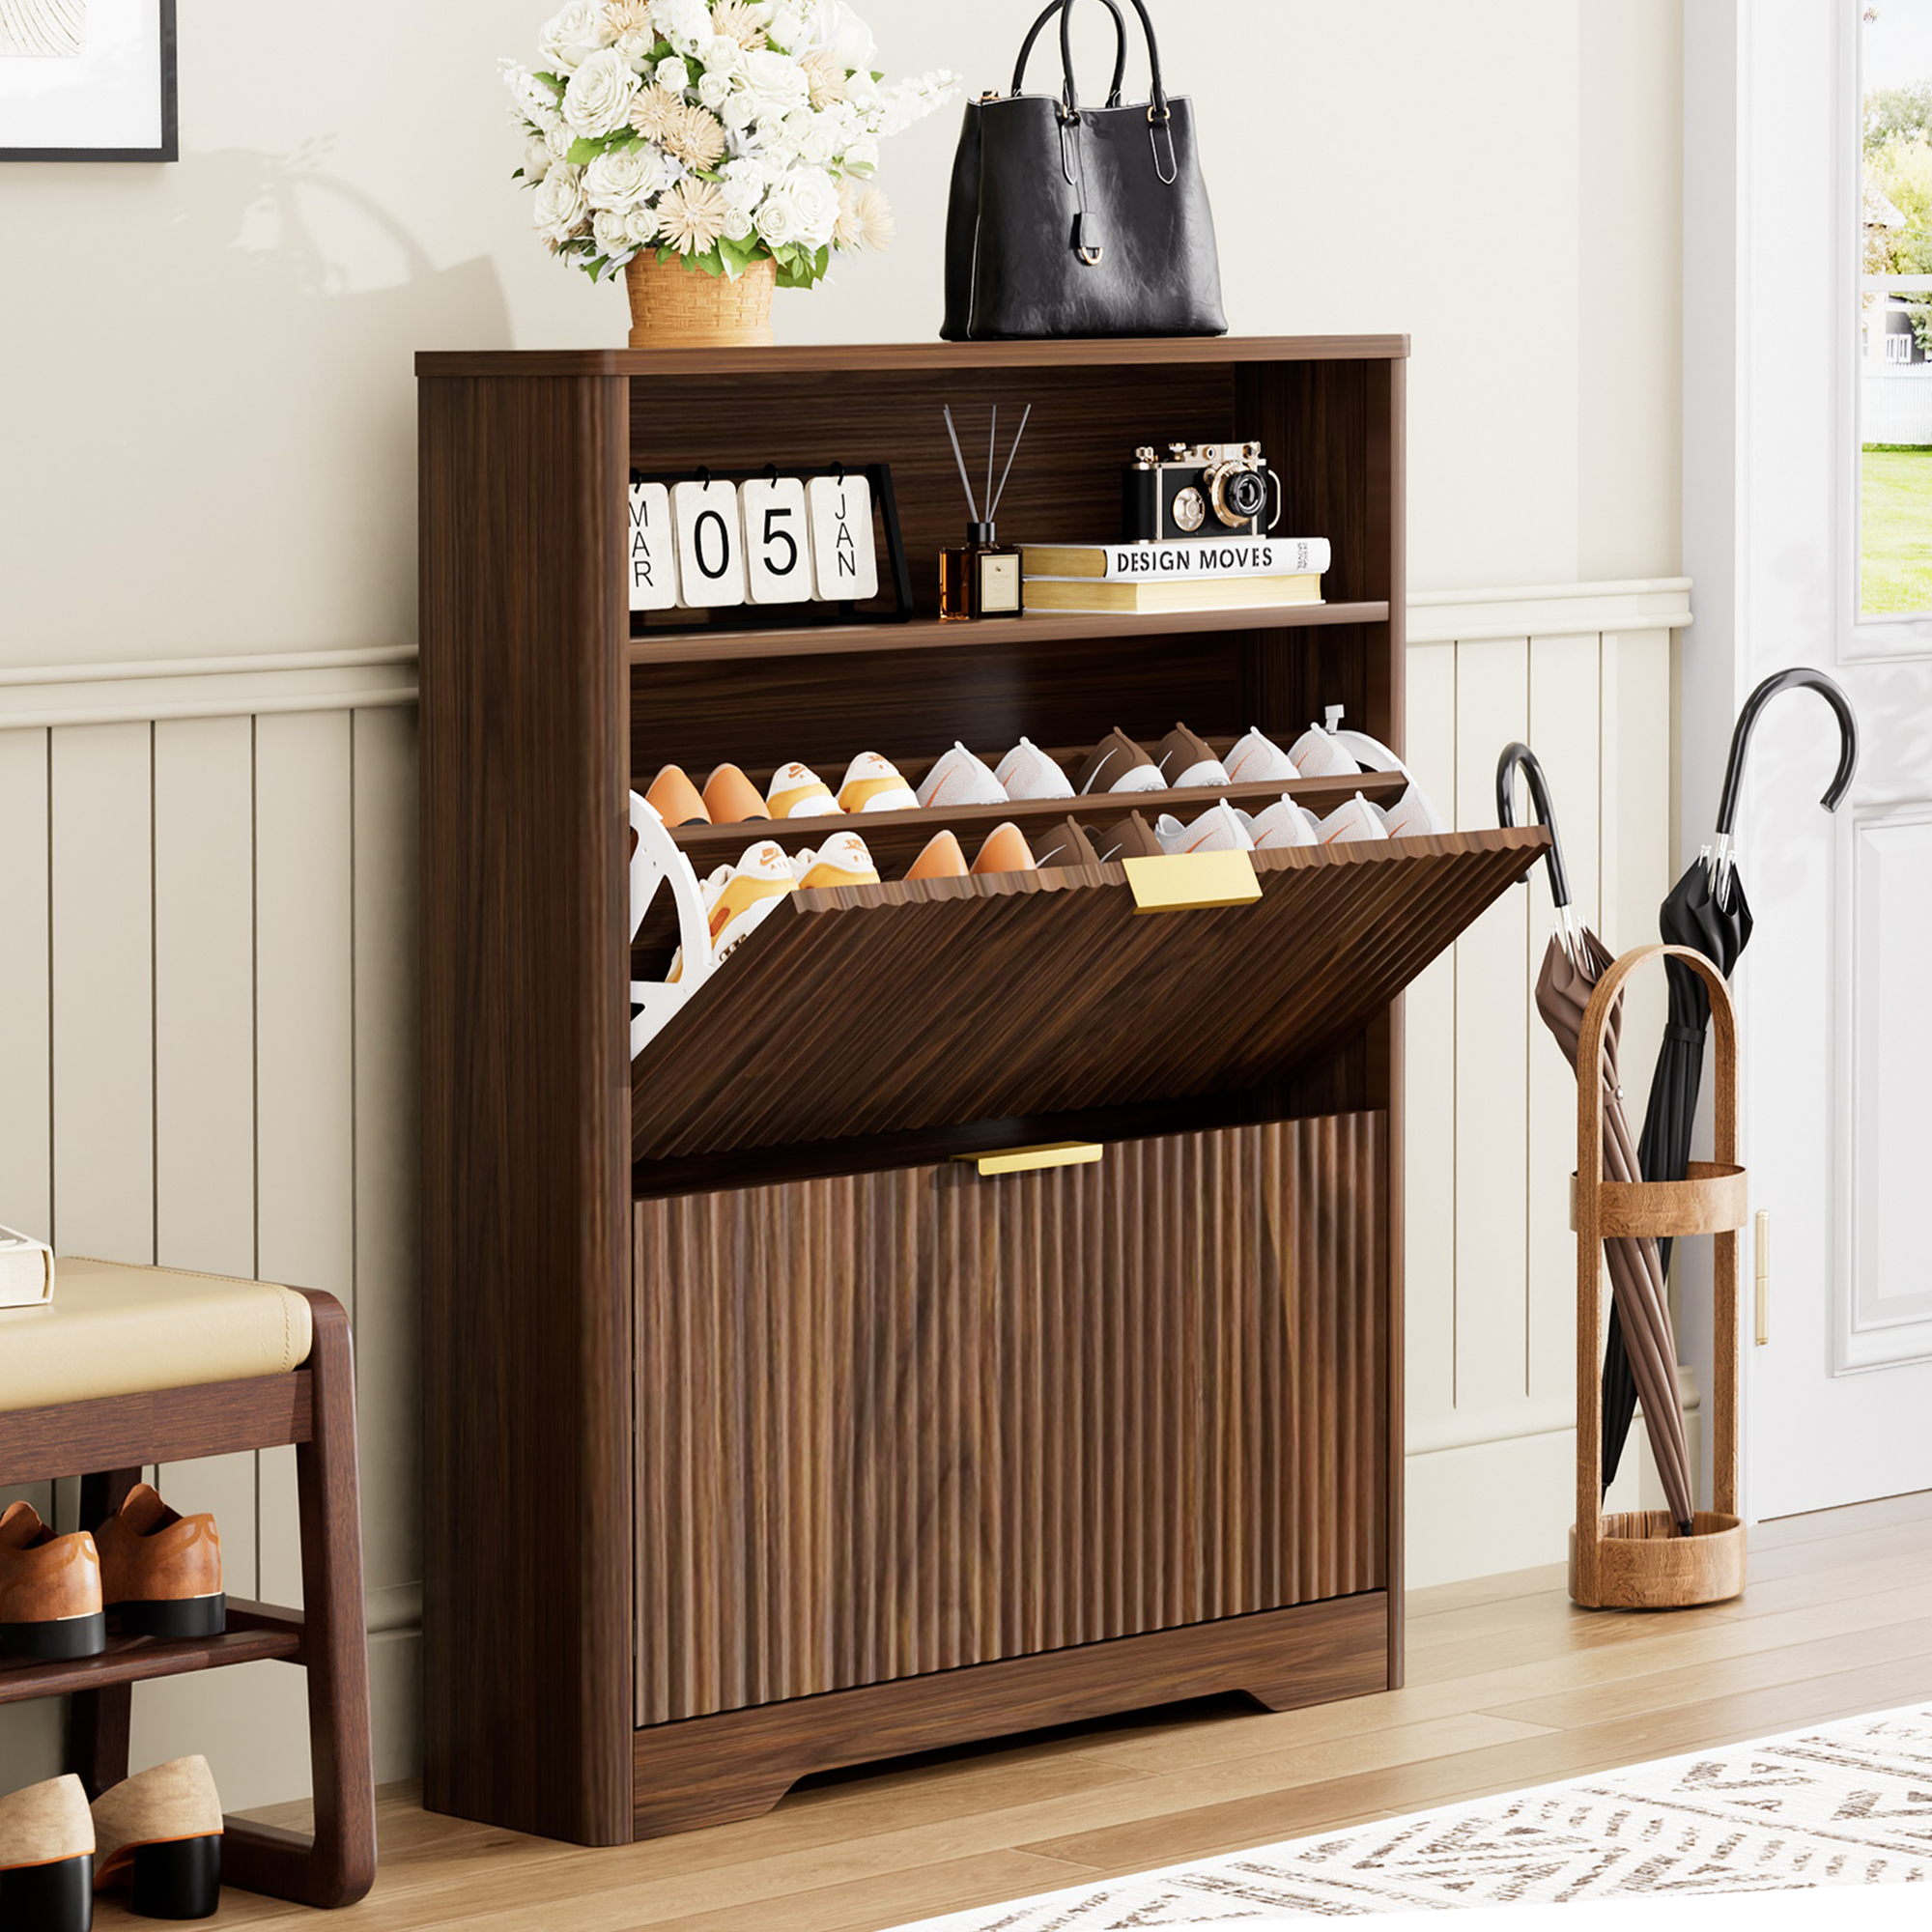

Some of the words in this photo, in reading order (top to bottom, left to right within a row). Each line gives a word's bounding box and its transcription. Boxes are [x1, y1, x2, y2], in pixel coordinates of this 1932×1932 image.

[629, 500, 654, 587] MAR
[835, 494, 857, 578] JAN
[1117, 550, 1190, 573] DESIGN
[1199, 547, 1273, 570] MOVES
